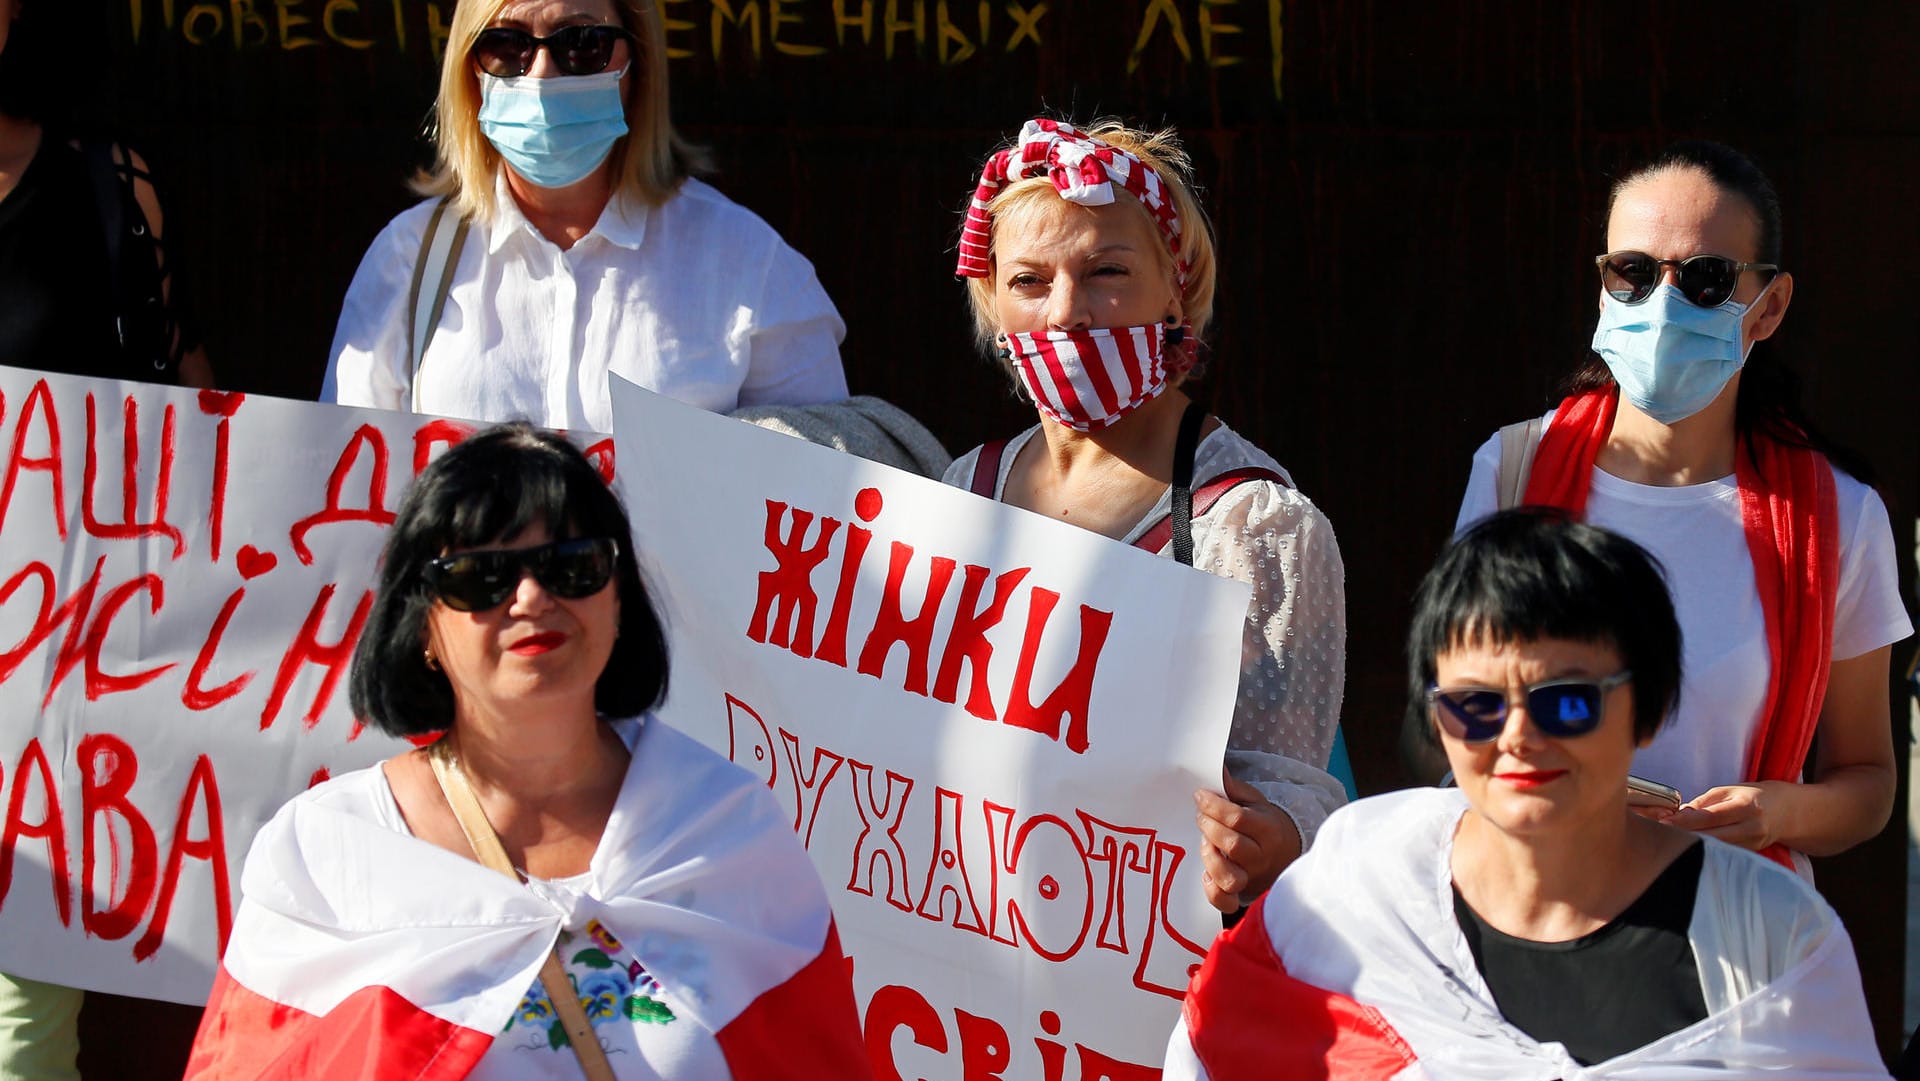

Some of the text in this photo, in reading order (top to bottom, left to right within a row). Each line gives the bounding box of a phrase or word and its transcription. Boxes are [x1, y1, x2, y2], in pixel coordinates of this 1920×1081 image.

[661, 0, 1049, 67] ЕМЕННЫХ
[0, 377, 246, 564] АЩІ
[746, 487, 1114, 755] ЖІНКИ
[0, 732, 234, 964] АВА
